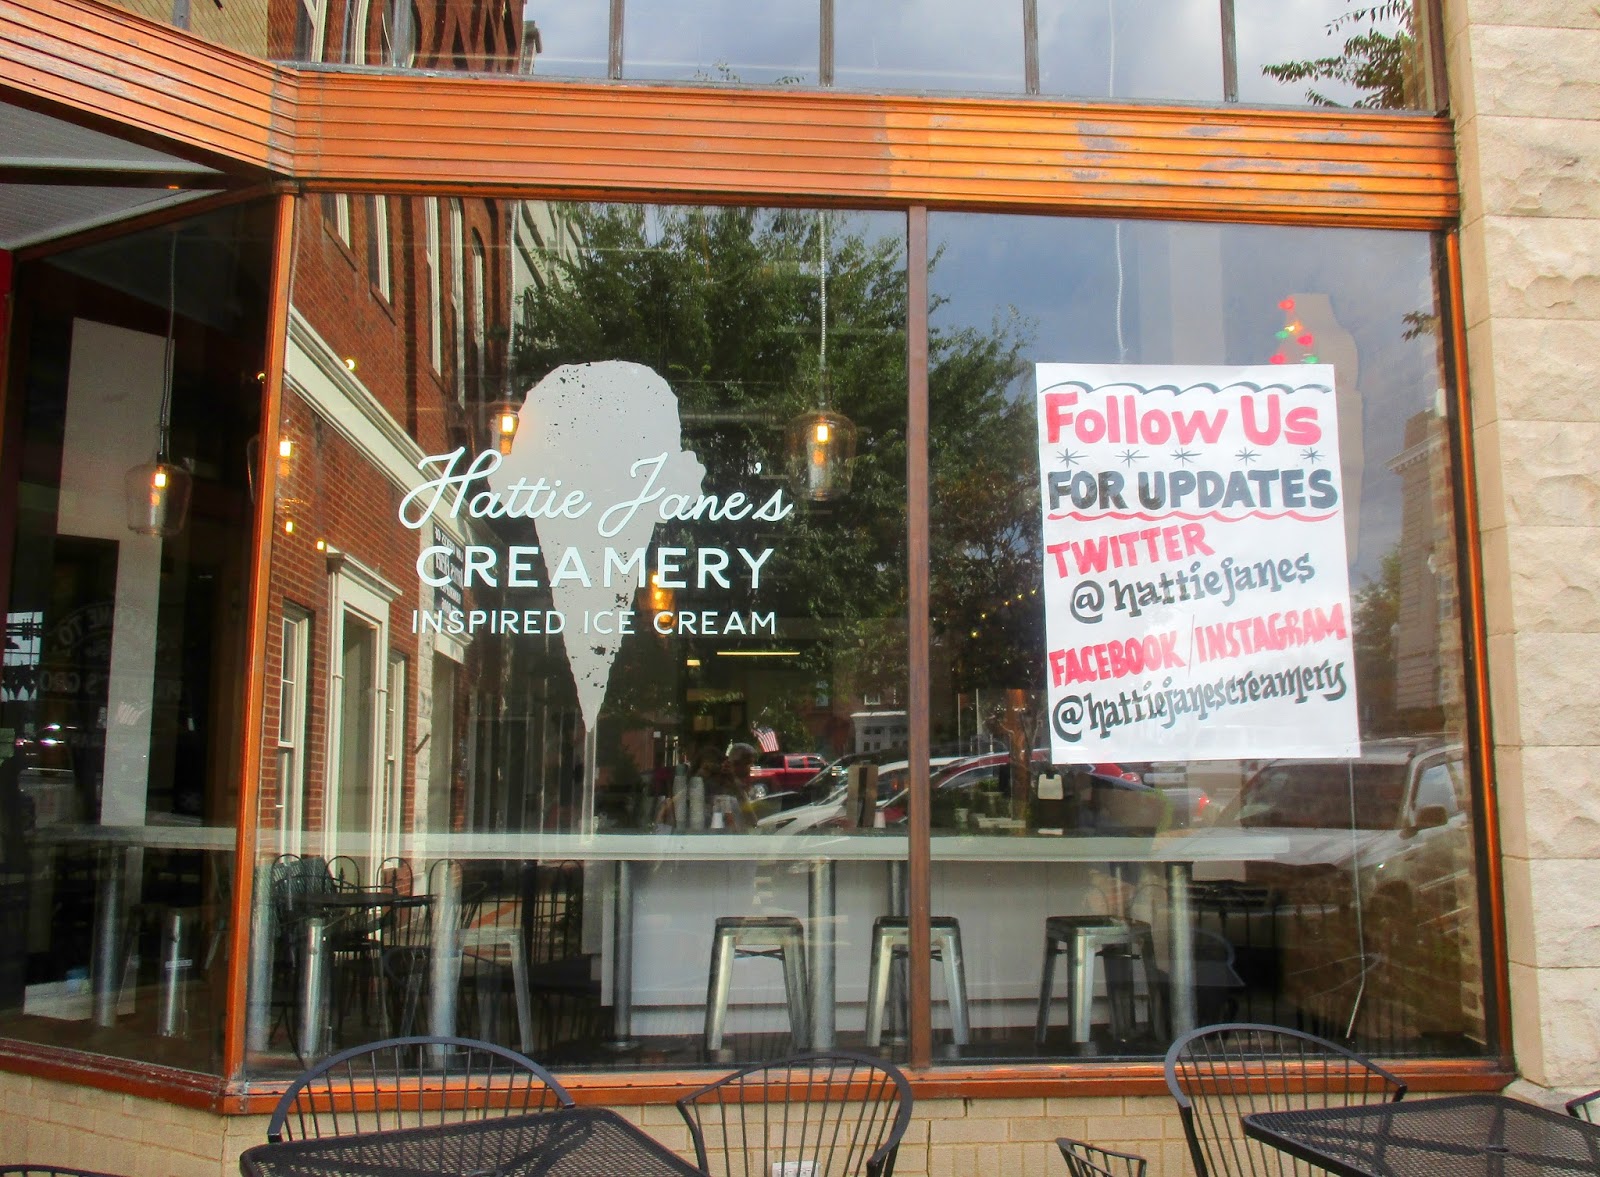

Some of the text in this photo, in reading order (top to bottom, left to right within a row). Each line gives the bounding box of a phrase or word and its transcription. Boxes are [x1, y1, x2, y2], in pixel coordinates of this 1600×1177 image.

[1045, 391, 1322, 446] Follow Us
[398, 446, 794, 538] Hattie Jane's
[1047, 468, 1339, 511] FOR UPDATES
[416, 545, 775, 589] CREAMERY
[1046, 522, 1216, 579] TWITTER
[1069, 553, 1316, 625] @hattiejanes
[411, 609, 777, 635] INSPIRED ICE CREAM
[1052, 658, 1347, 743] @hattiejanescreamery
